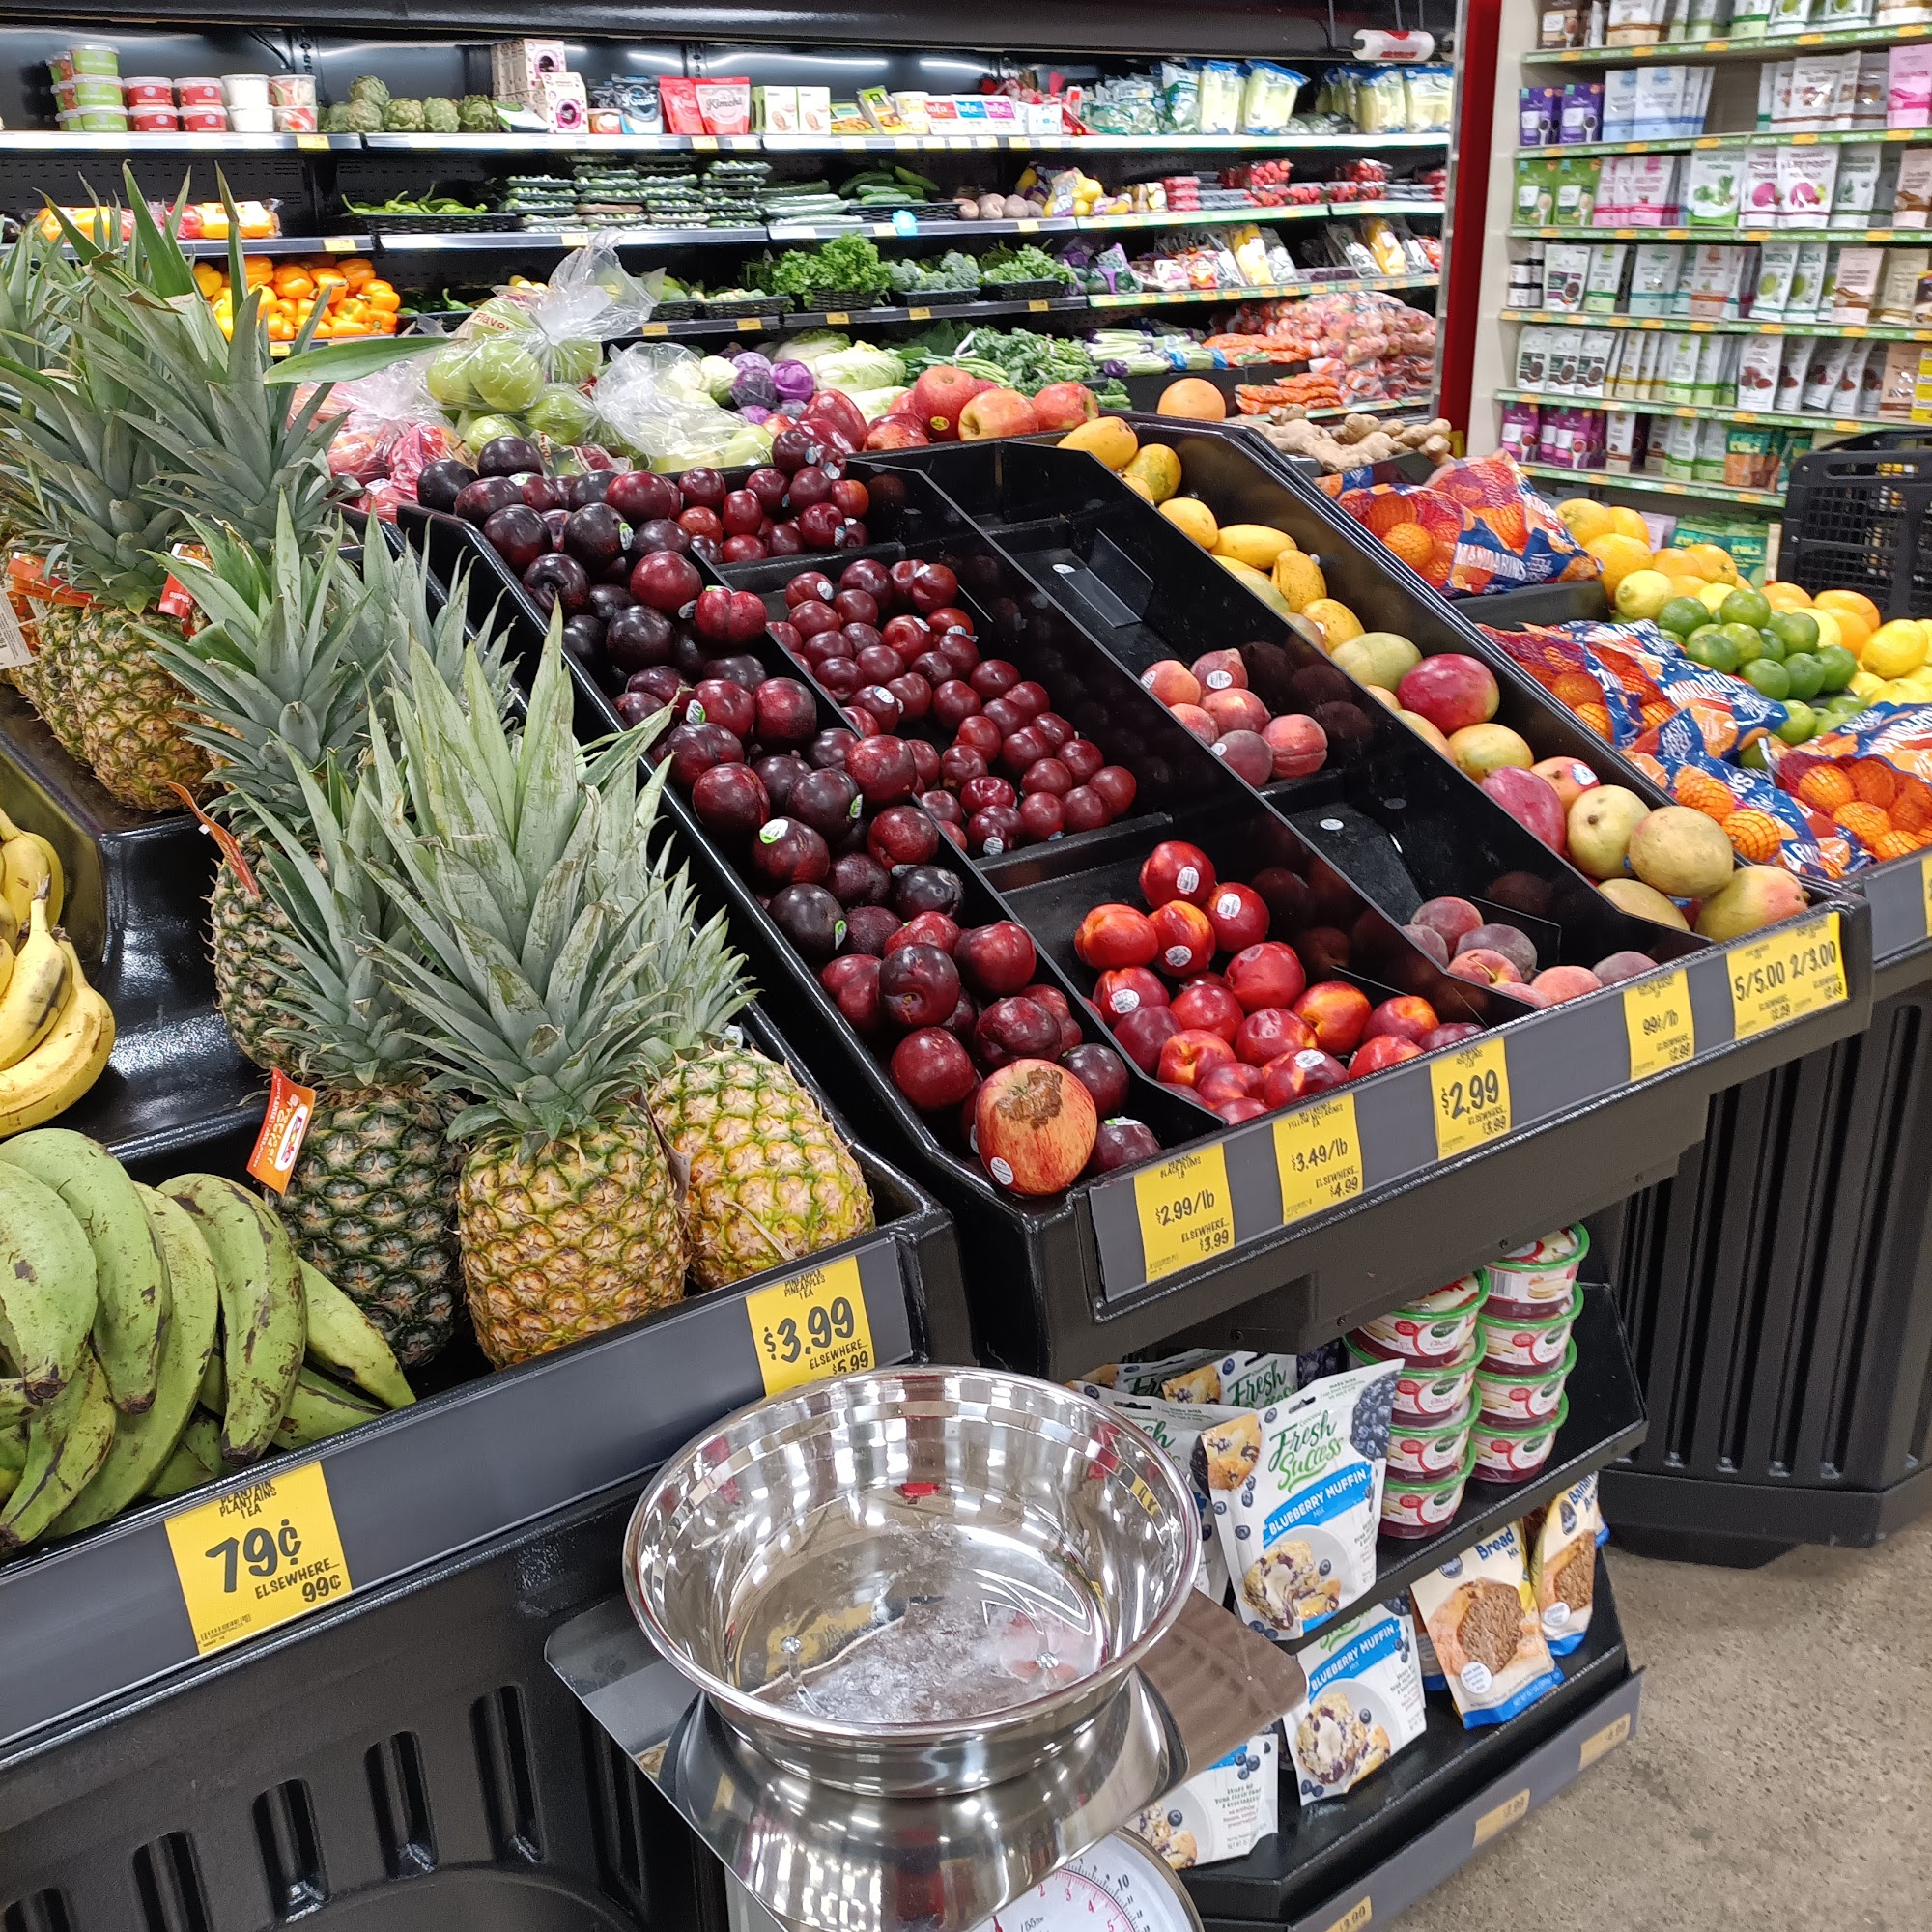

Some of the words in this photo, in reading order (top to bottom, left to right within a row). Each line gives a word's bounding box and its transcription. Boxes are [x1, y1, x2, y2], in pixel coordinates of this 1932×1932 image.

[1441, 1069, 1499, 1119] $2.99
[1291, 1138, 1348, 1172] $3.49/lb
[1330, 1176, 1358, 1198] $4.99
[1155, 1189, 1215, 1227] $2.99/lb
[1199, 1229, 1229, 1252] $3.99
[783, 1275, 826, 1297] PINEAPPLES
[763, 1296, 855, 1364] $3.99
[1267, 1410, 1338, 1473] Fresh
[1277, 1436, 1345, 1492] Success
[218, 1487, 277, 1518] PLANTAINS
[247, 1503, 262, 1517] EA
[1268, 1491, 1325, 1536] BLUEBERRY
[1324, 1468, 1368, 1501] MUFFIN
[204, 1518, 302, 1594] 79¢
[1476, 1526, 1515, 1562] Bread
[301, 1574, 342, 1603] 99¢
[1310, 1647, 1359, 1691] BLUEBERRY
[1359, 1623, 1395, 1655] MUFFIN
[1038, 1883, 1045, 1897] 2
[1065, 1888, 1072, 1902] 3
[1118, 1873, 1129, 1892] 10
[1088, 1899, 1094, 1914] 4
[1107, 1919, 1115, 1932] 5
